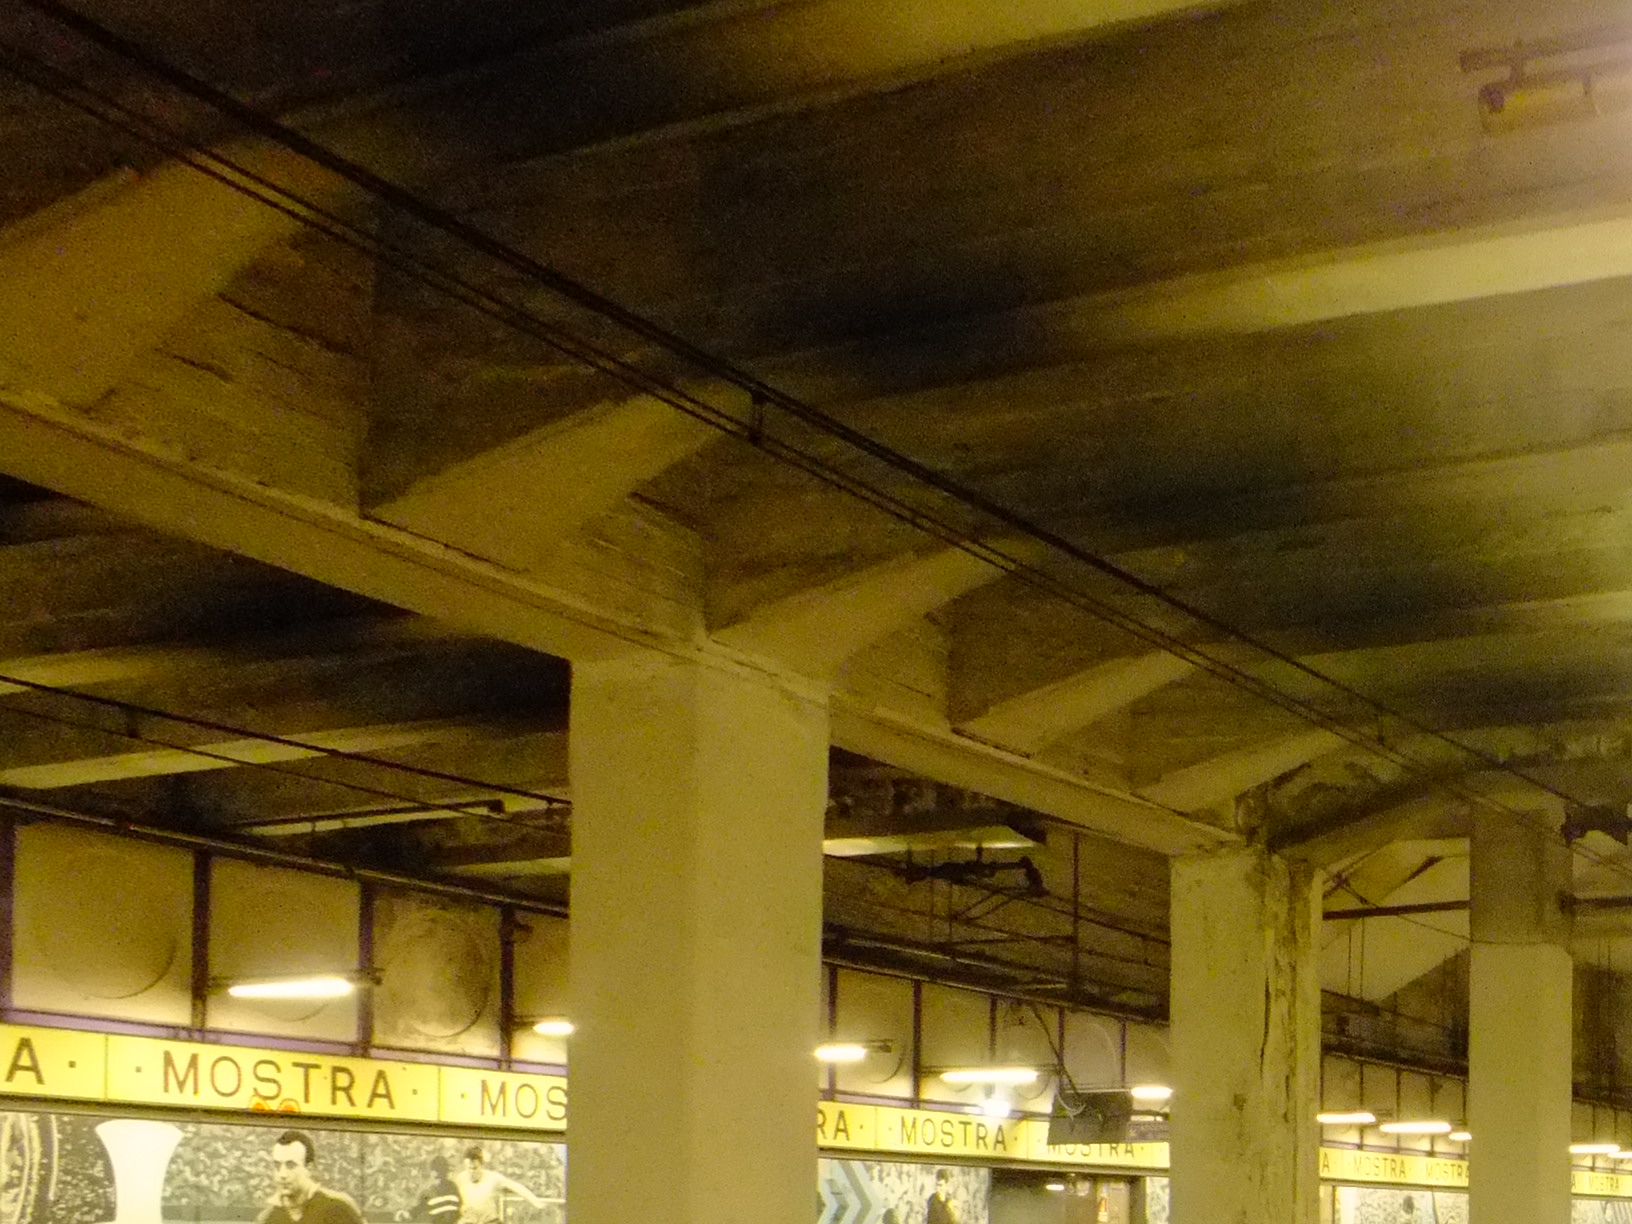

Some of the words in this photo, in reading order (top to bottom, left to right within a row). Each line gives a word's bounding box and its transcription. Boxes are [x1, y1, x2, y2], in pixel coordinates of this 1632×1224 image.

[162, 1050, 396, 1109] MOSTRA
[480, 1079, 568, 1121] MOS
[900, 1115, 1007, 1152] MOSTRA
[1353, 1154, 1407, 1178] MOSTRA
